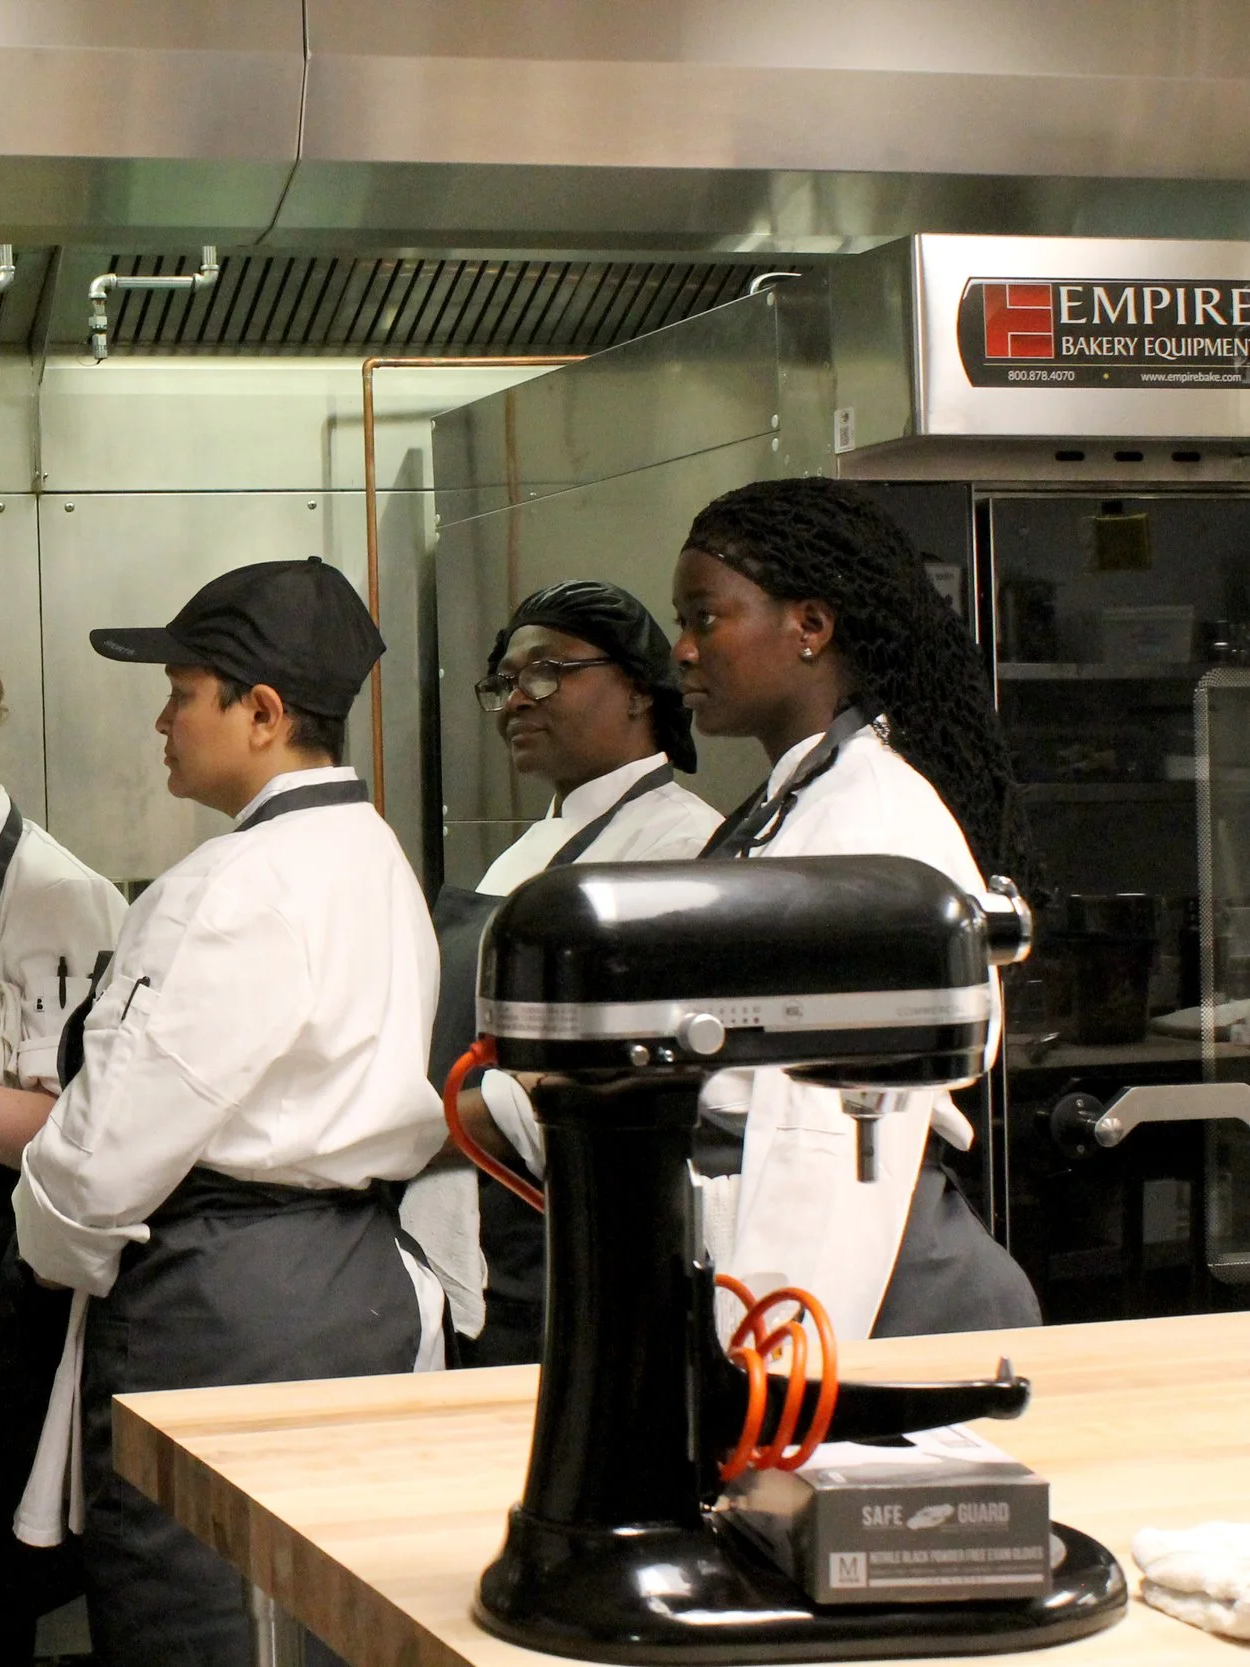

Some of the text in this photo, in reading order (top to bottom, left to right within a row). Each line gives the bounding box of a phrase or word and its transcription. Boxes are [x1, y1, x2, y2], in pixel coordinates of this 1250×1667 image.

[1059, 285, 1250, 326] EMPIRE
[1061, 336, 1250, 360] BAKERY EQUIPMEN
[1008, 370, 1242, 383] 800.878.4070 www.empirebake.com
[861, 1502, 1010, 1526] SAFE GUARD
[840, 1556, 858, 1576] M
